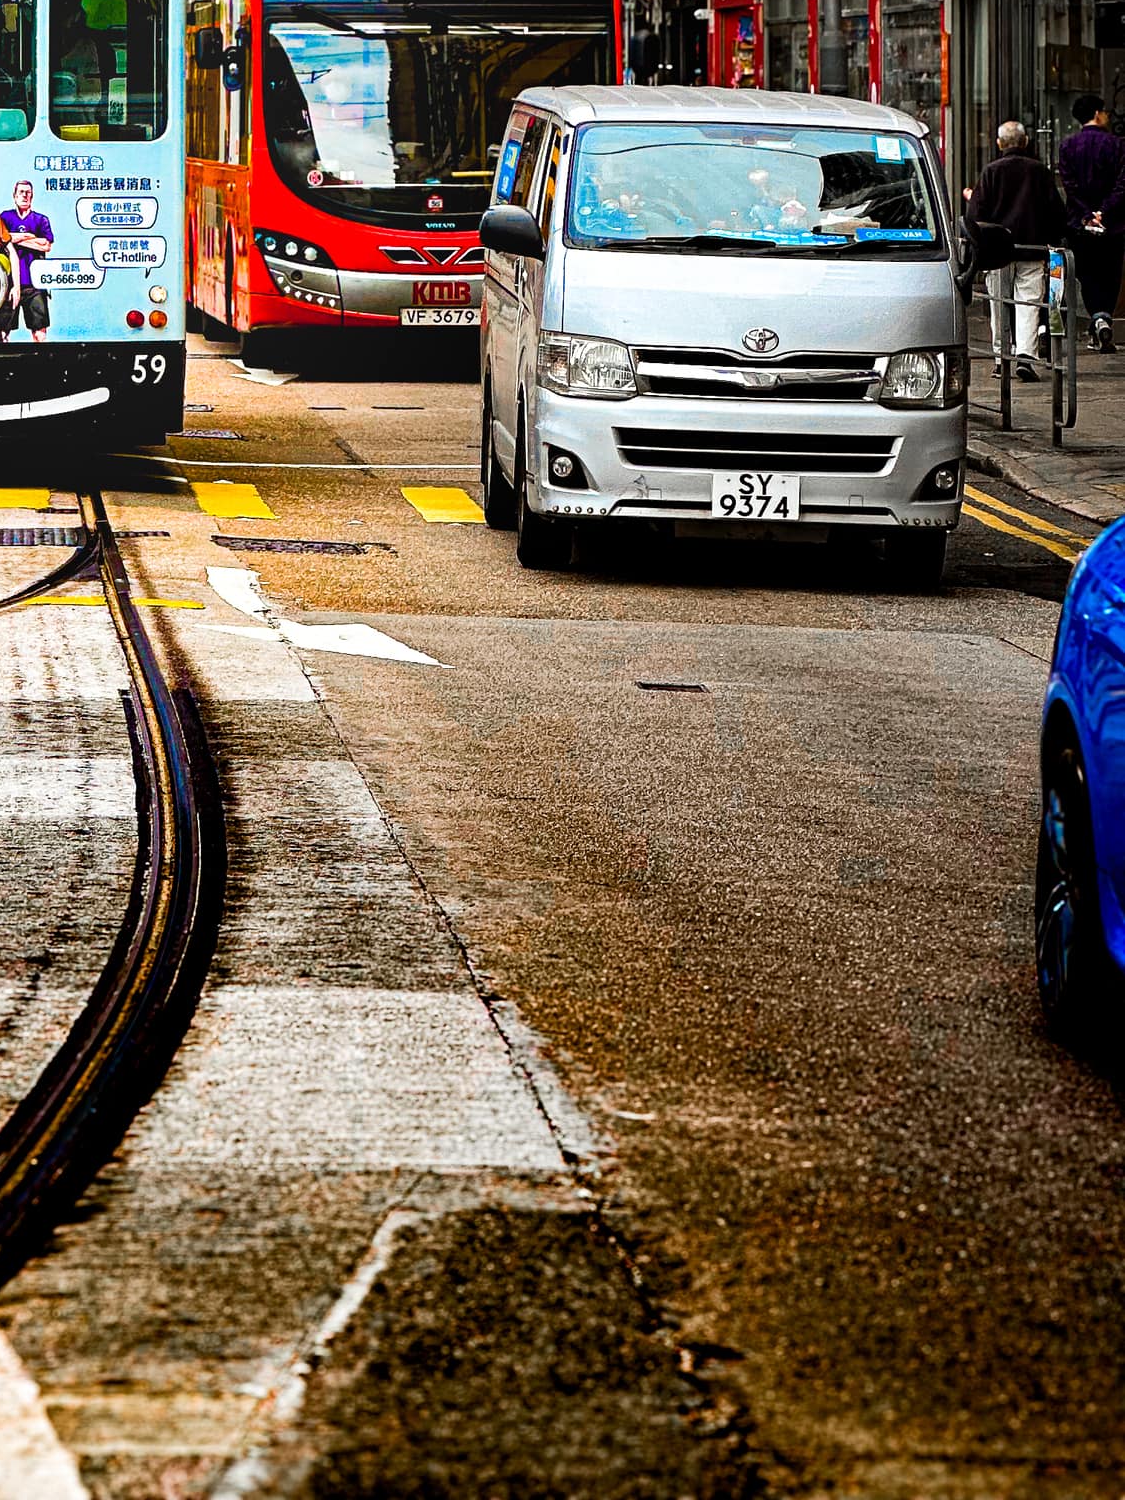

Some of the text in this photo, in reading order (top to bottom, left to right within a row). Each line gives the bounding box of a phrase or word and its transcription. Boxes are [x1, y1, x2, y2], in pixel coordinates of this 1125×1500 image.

[92, 202, 141, 213] 微信小程式
[102, 252, 157, 263] CT-hotline
[61, 263, 80, 272] 短訊
[40, 274, 95, 284] 63-666-999
[412, 281, 472, 305] KMB
[406, 310, 475, 323] VF 3679
[131, 354, 166, 384] 59
[738, 473, 774, 495] SY
[719, 494, 789, 518] 9374
